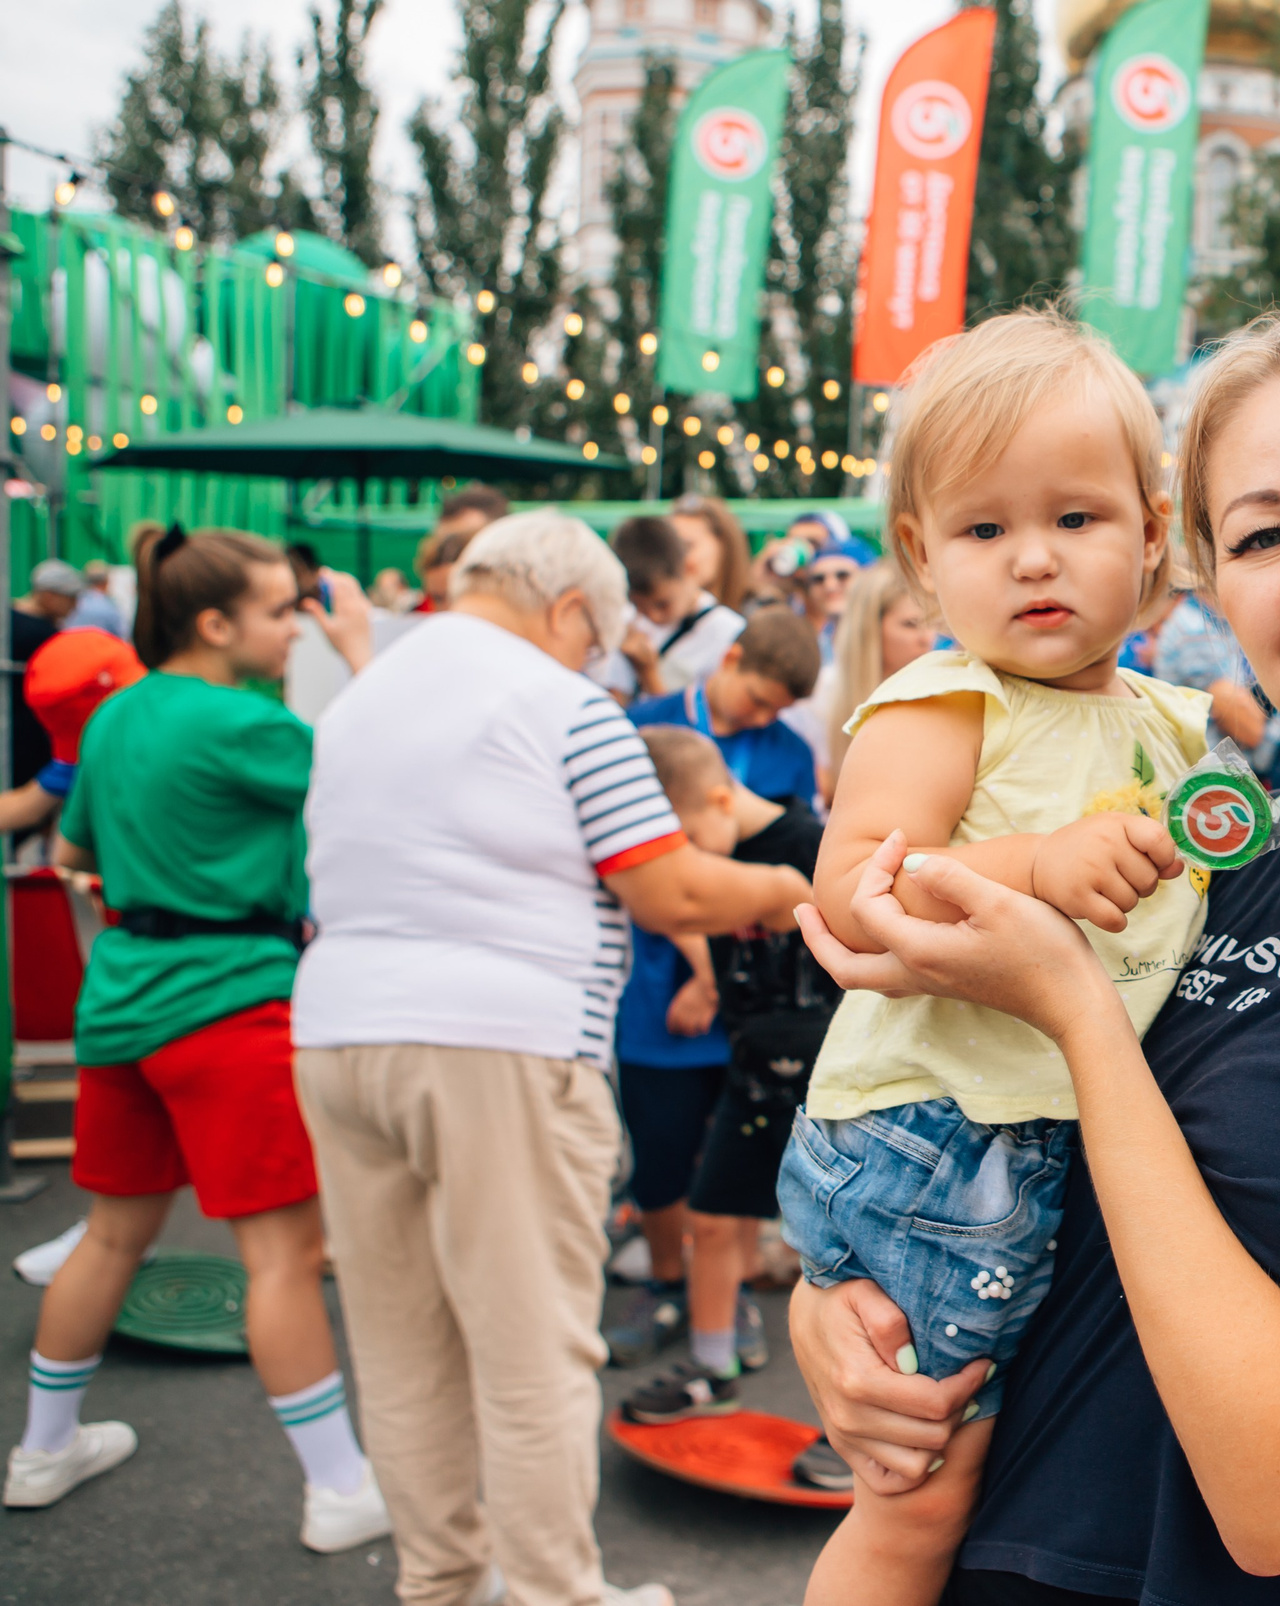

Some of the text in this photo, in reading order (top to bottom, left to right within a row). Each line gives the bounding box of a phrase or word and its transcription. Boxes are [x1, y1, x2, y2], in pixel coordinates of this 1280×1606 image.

[1196, 801, 1250, 840] 5
[1176, 969, 1271, 1012] EST. 19
